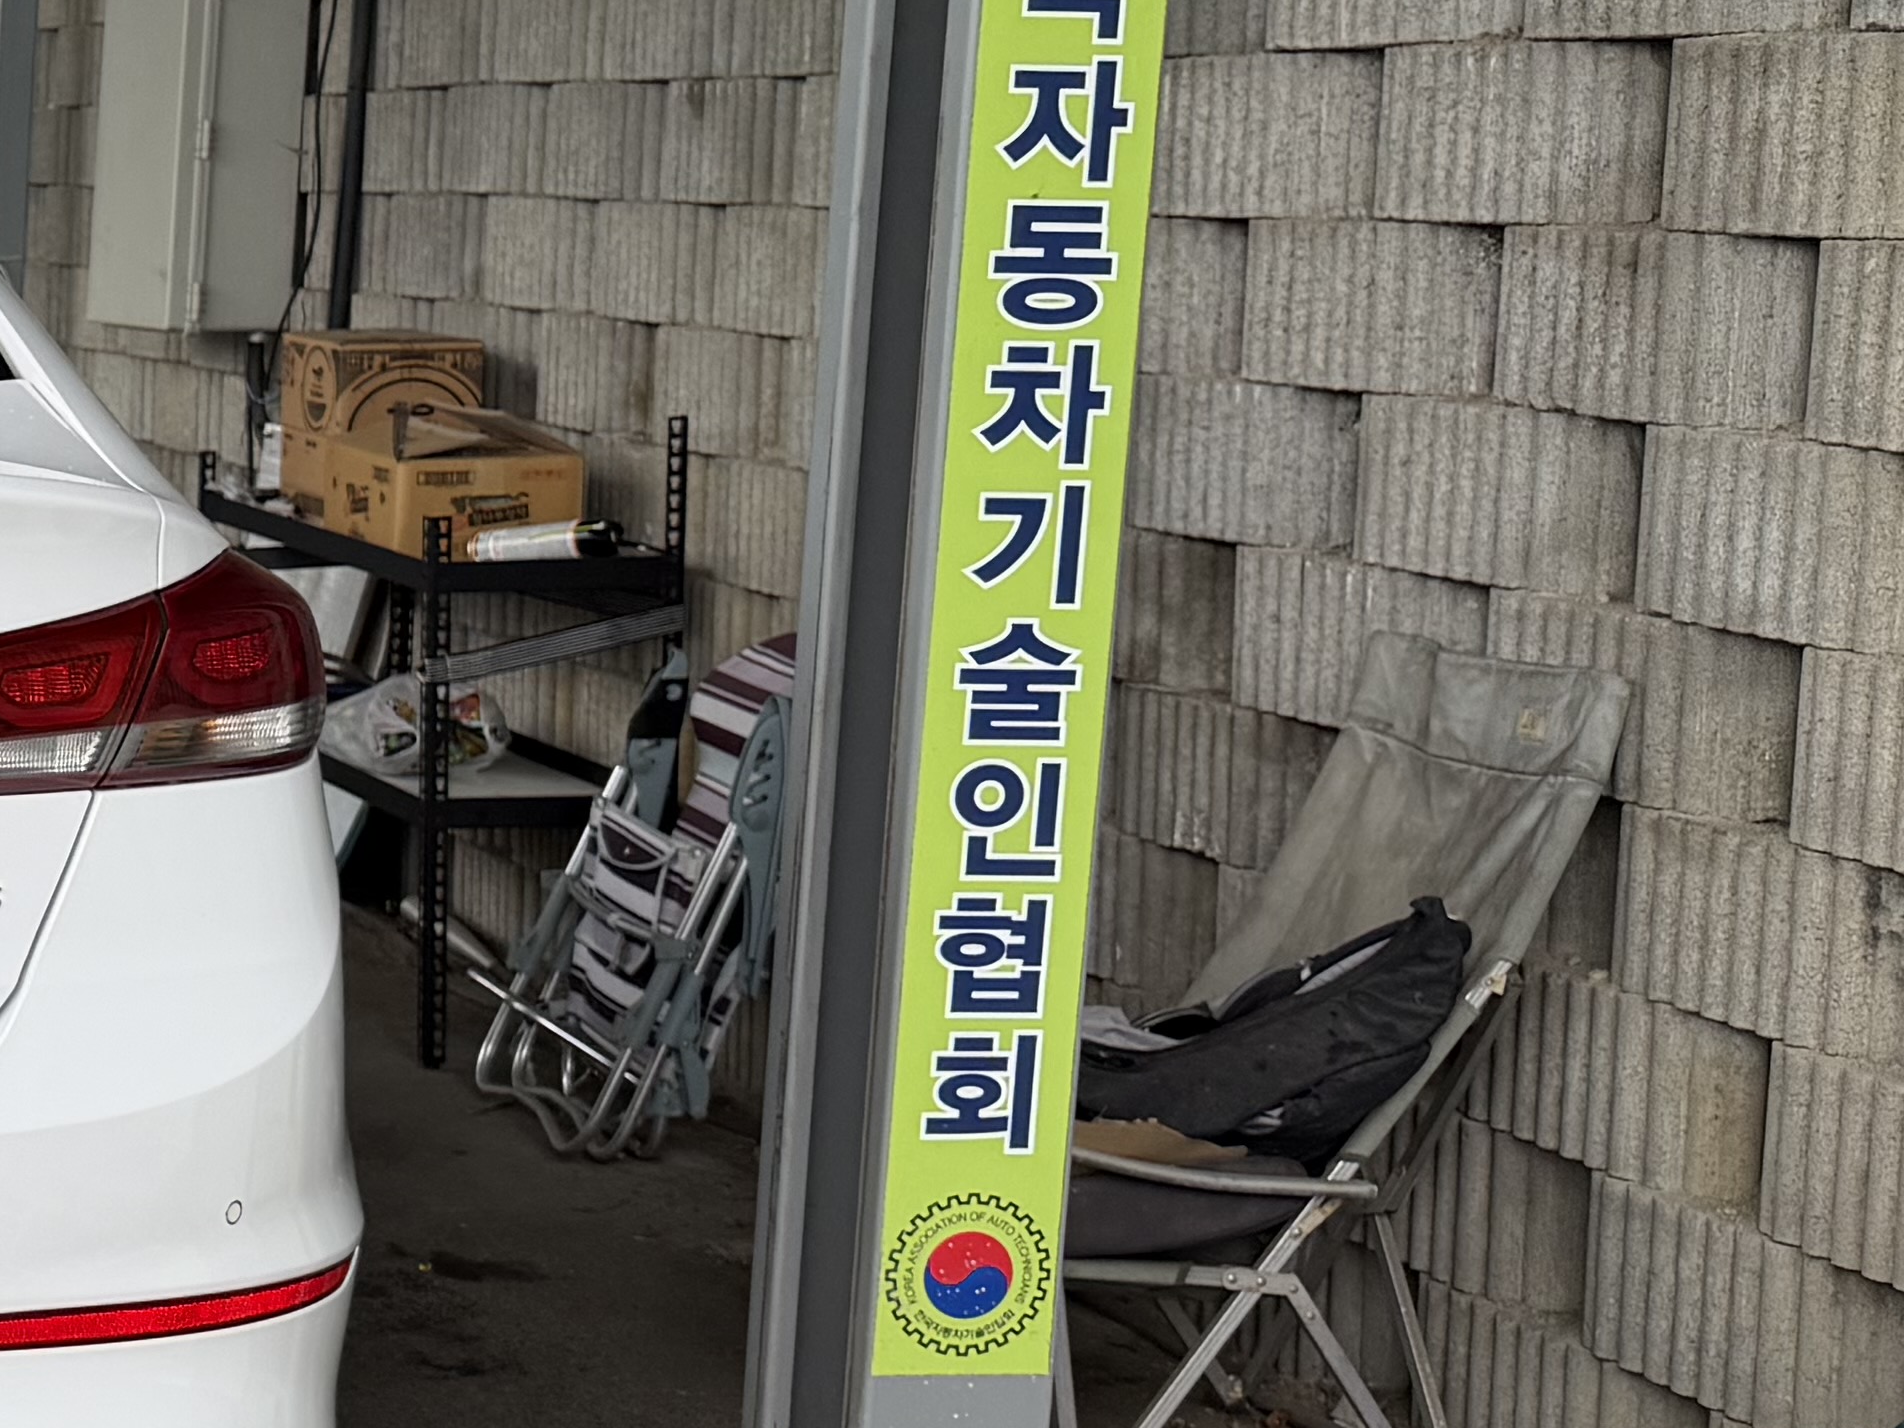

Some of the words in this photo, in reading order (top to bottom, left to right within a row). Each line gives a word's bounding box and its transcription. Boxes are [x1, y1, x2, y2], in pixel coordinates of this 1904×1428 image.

[969, 1211, 986, 1222] OF
[986, 1214, 1016, 1235] AUTO
[908, 1212, 967, 1264] ASSOCIATION
[902, 1267, 918, 1306] KOREA
[1012, 1233, 1033, 1305] TECHNICIANS
